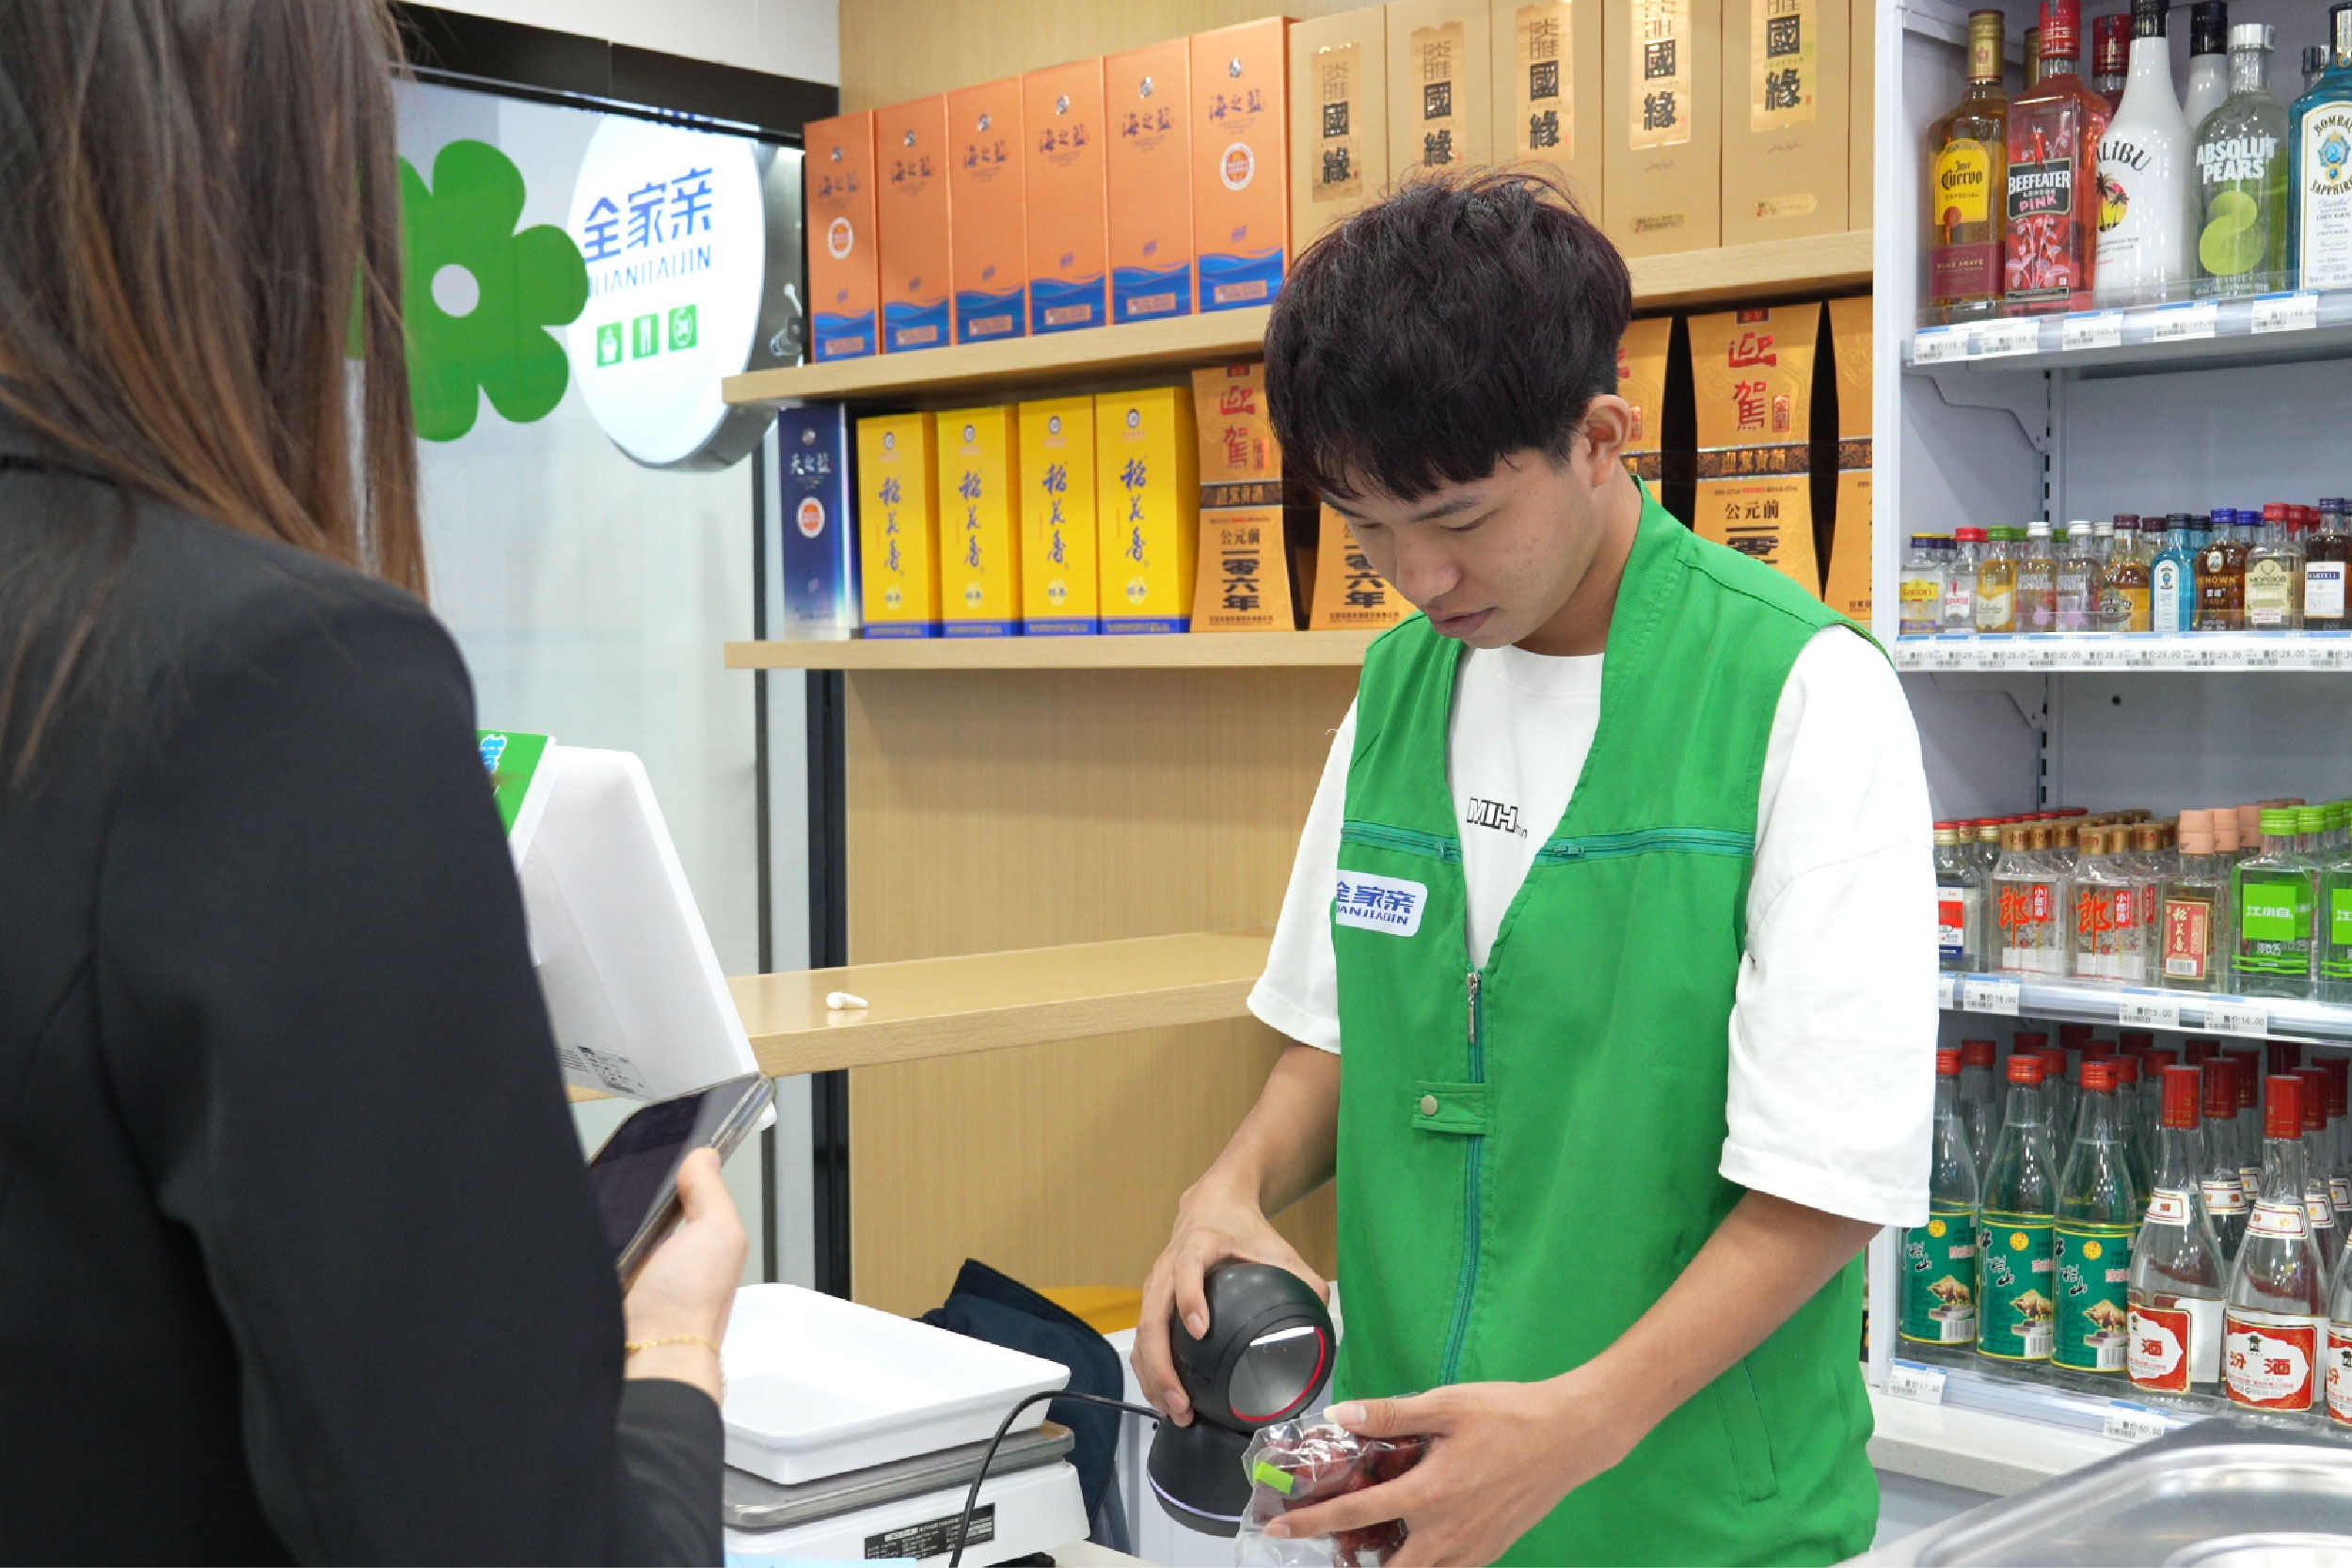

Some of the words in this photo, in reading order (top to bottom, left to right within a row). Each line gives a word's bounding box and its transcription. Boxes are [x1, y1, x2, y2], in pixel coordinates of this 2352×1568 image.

[2097, 141, 2151, 171] LIBU
[2197, 136, 2278, 166] ABSOLUT
[1942, 169, 1982, 190] Cuervo
[2202, 160, 2265, 184] PEARS
[2009, 171, 2071, 195] BEEFEATER
[2024, 188, 2056, 198] LONDON
[2019, 195, 2057, 212] PINK
[584, 167, 713, 264] 全家亲
[1725, 499, 1779, 519] 公元前
[1221, 528, 1260, 546] 公元前
[1336, 880, 1416, 914] 全家亲
[1337, 905, 1410, 926] ANJIAQIN
[2247, 905, 2291, 918] 江小白
